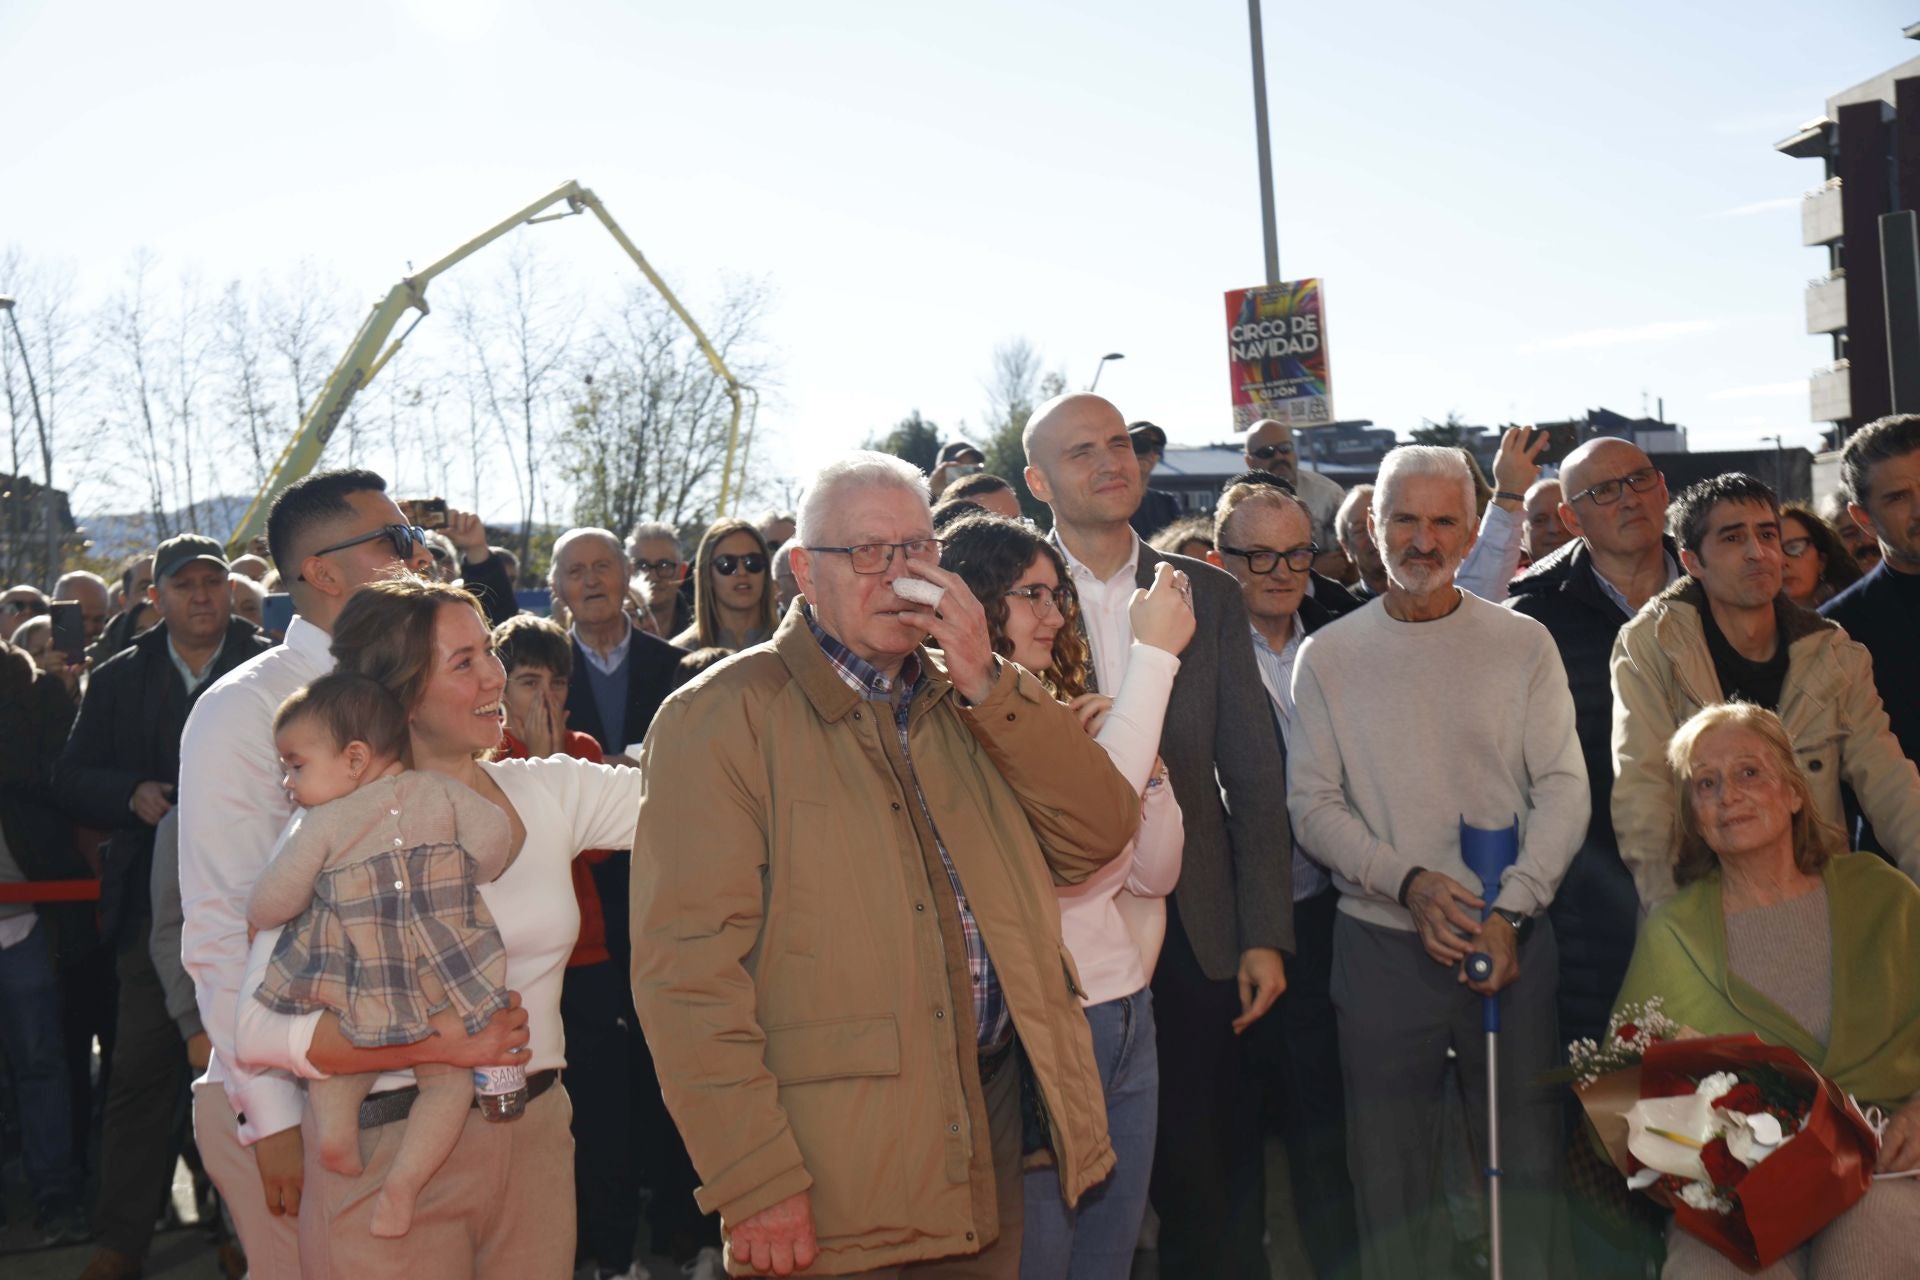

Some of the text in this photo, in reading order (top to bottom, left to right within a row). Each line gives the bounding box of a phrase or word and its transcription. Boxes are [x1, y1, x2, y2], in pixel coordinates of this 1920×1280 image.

[1231, 314, 1318, 342] CIRCO DE
[1231, 333, 1319, 362] NAVIDAD
